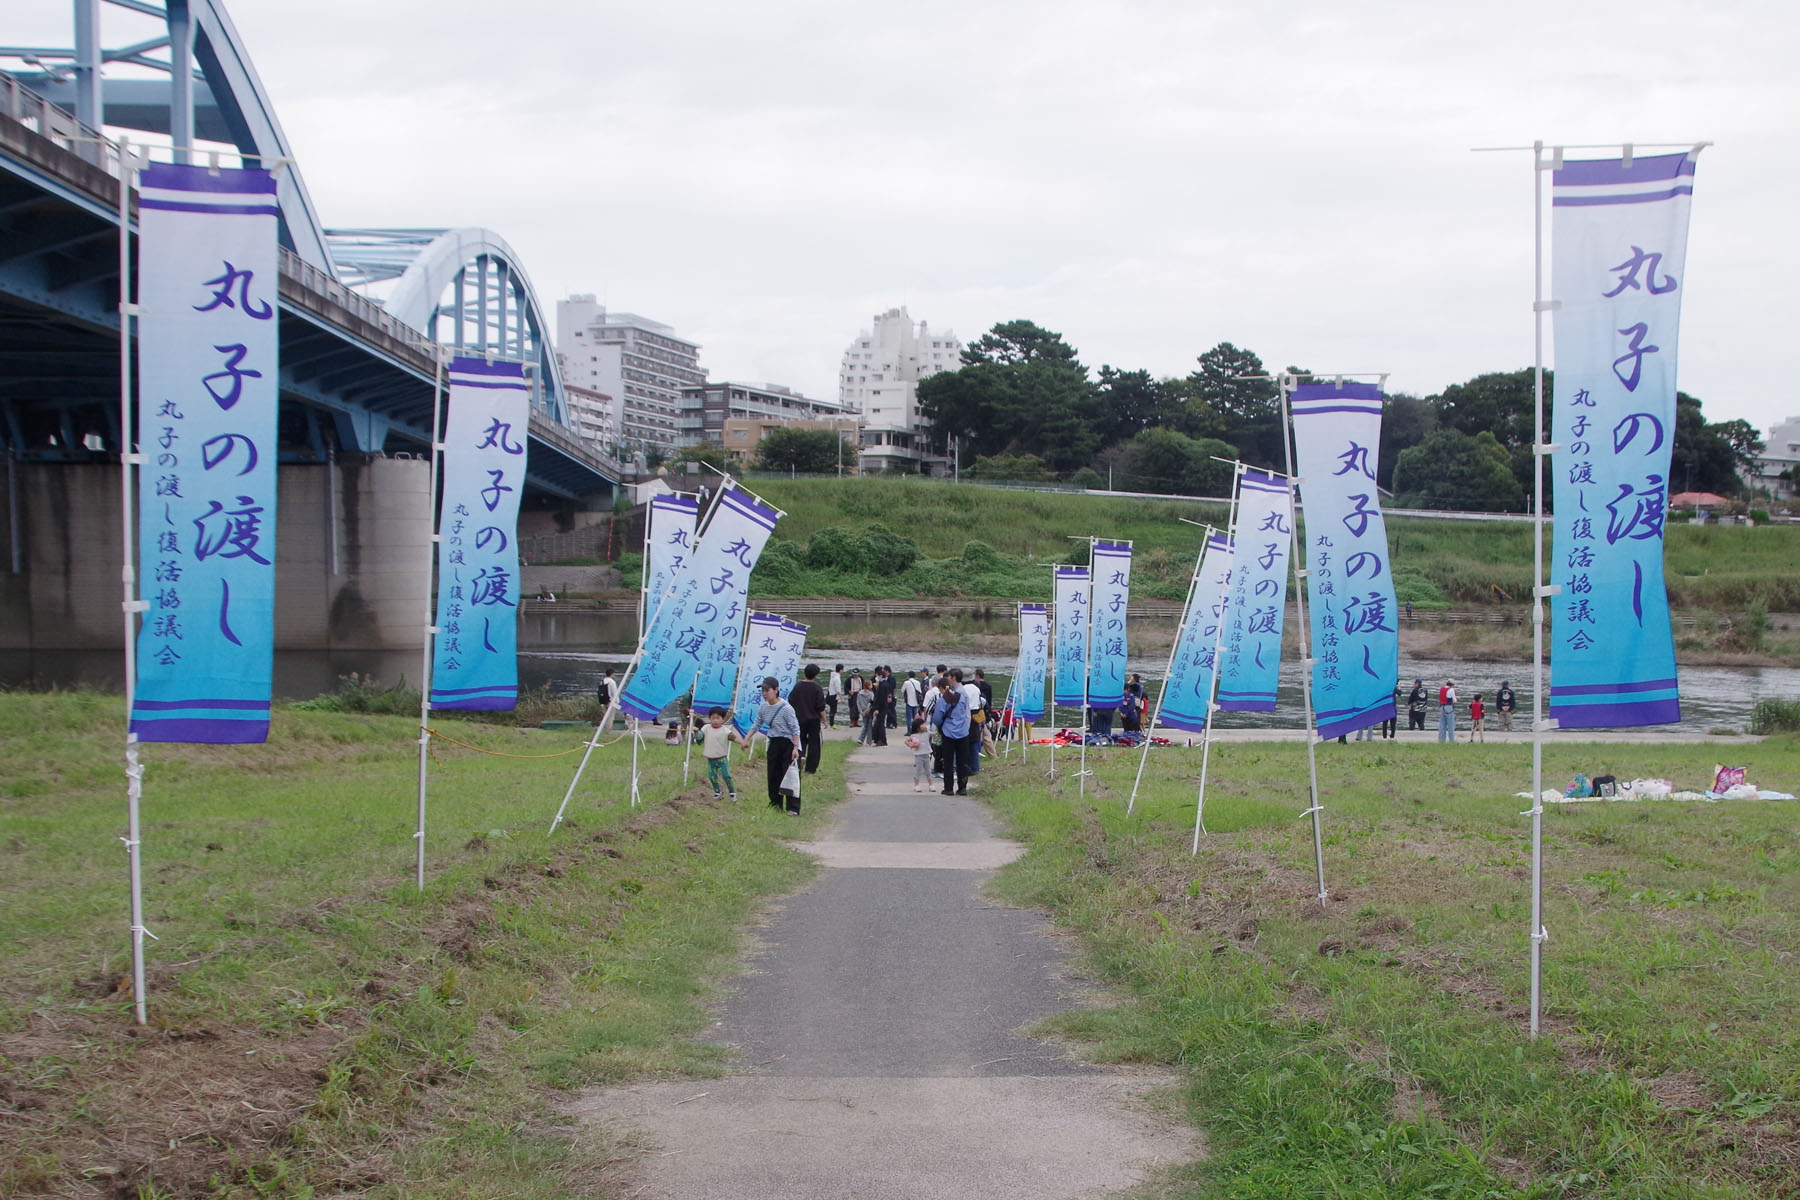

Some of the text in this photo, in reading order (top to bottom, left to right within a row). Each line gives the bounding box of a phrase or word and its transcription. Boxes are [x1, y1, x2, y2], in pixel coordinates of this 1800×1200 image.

[192, 260, 273, 647] 丸子の渡し
[1566, 387, 1597, 652] 丸子の渡し復活協議会
[1602, 245, 1677, 629] 丸子の渡し
[154, 398, 185, 667] 丸子の渡し復活協議会
[442, 502, 470, 672] 丸子の渡し復活協議会
[471, 416, 523, 655] 丸子の渡し
[671, 537, 752, 690] 丸子の渡し
[1249, 511, 1291, 671] 丸子の渡し
[1316, 534, 1341, 691] 丸子の渡し復活協議会
[1332, 440, 1396, 681] 丸子の渡し
[716, 588, 746, 688] 子の渡し
[1033, 624, 1048, 700] 丸子の渡し
[1067, 590, 1087, 683] 丸子の渡し
[1105, 570, 1130, 682] 丸子の渡し
